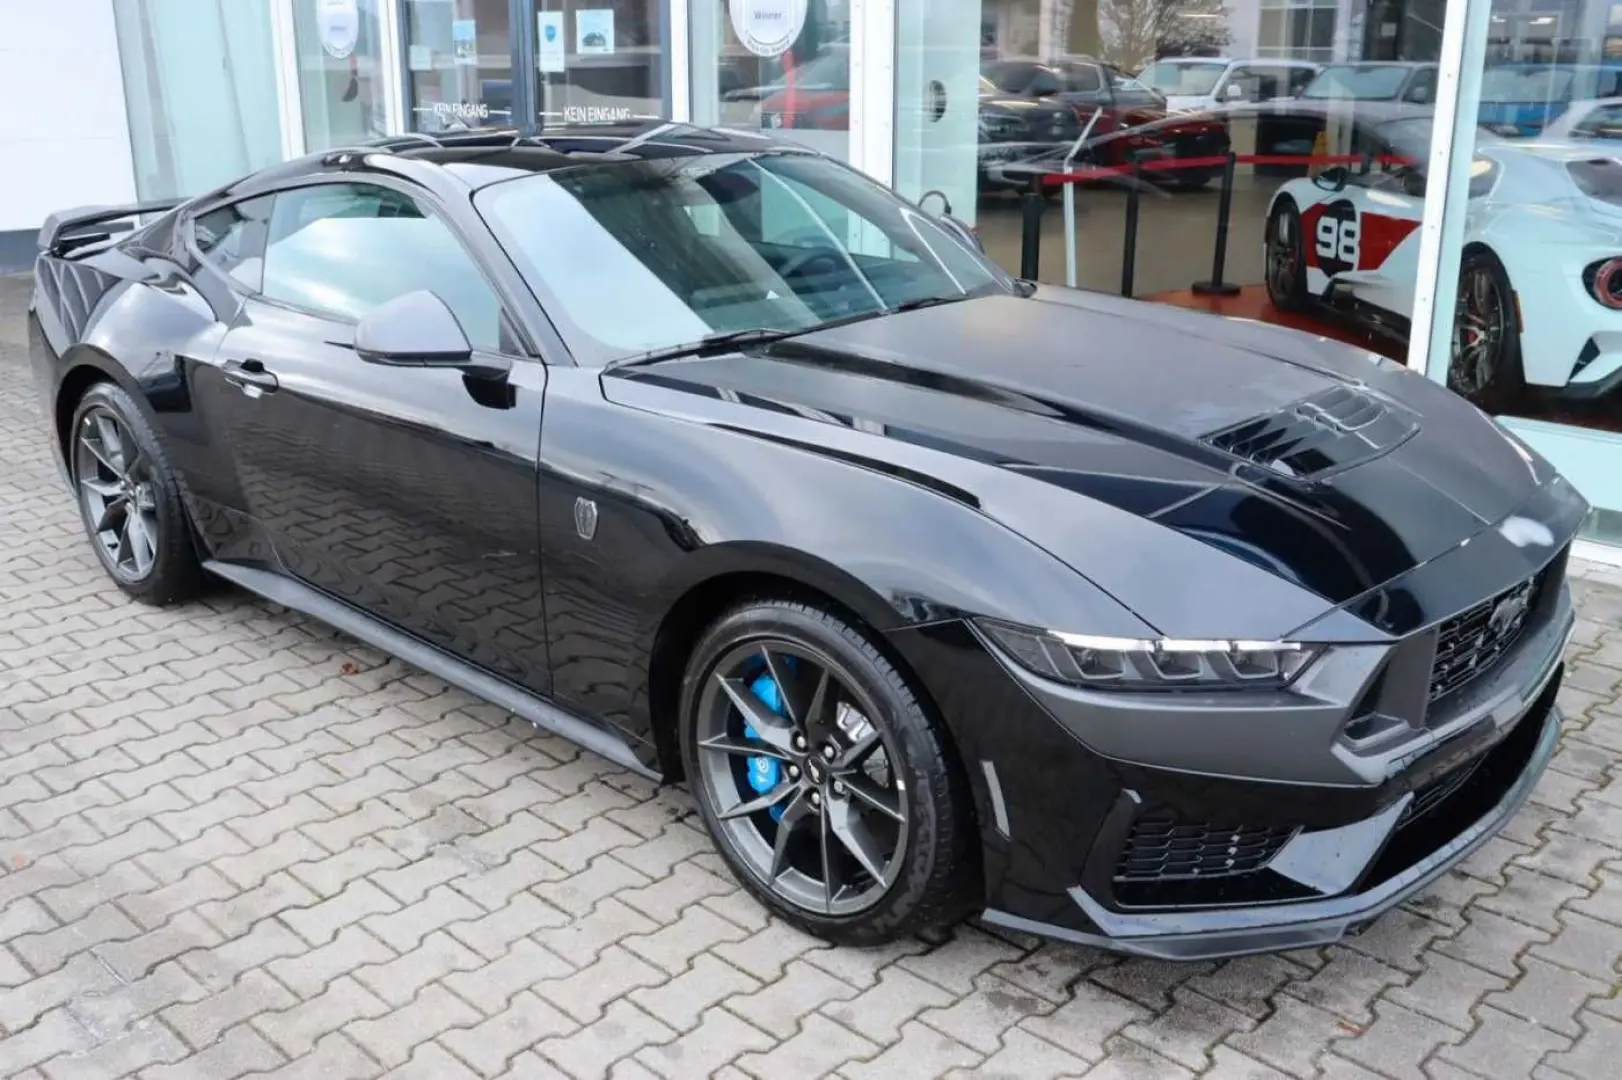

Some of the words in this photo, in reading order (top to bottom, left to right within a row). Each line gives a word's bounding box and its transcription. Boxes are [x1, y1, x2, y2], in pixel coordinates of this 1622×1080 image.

[563, 106, 587, 122] KEIN
[588, 106, 631, 122] EINGANG
[1316, 215, 1359, 265] 98
